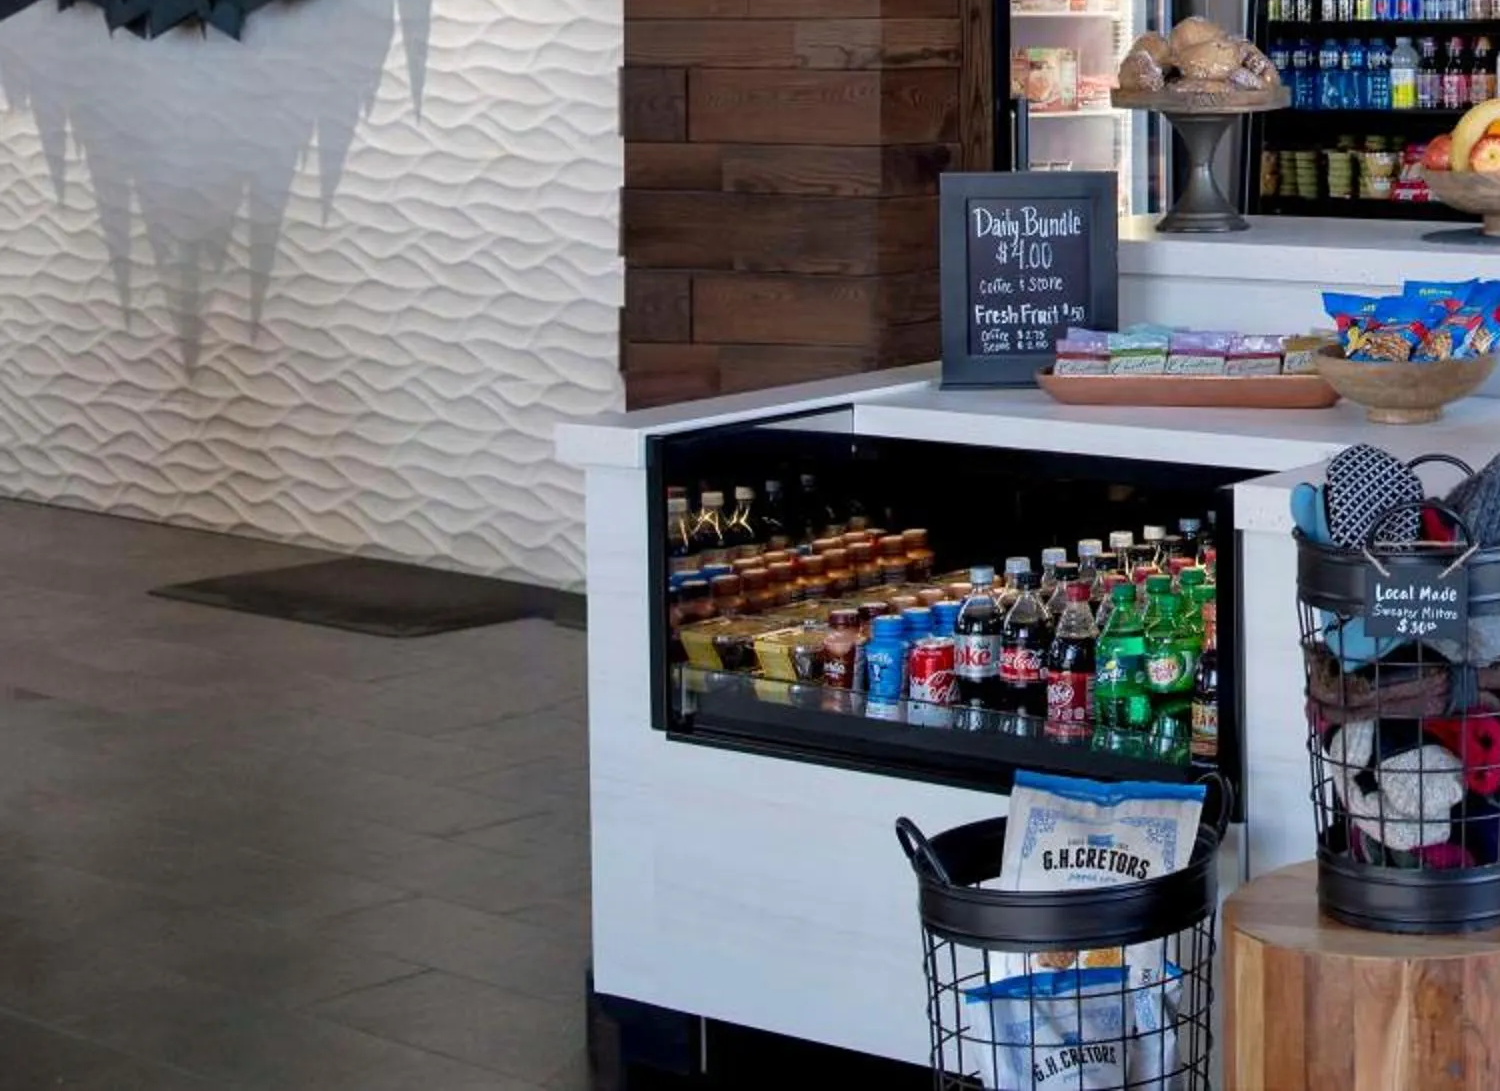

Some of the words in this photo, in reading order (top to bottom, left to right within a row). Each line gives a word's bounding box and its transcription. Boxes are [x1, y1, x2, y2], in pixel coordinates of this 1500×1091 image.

[973, 207, 1019, 249] Daily
[1020, 206, 1081, 238] Bundle
[995, 239, 1053, 270] $4.00
[974, 303, 1019, 325] Fresh
[1020, 303, 1060, 325] Fruit
[1375, 583, 1415, 602] Local
[1419, 585, 1458, 602] Made
[954, 645, 991, 666] oke
